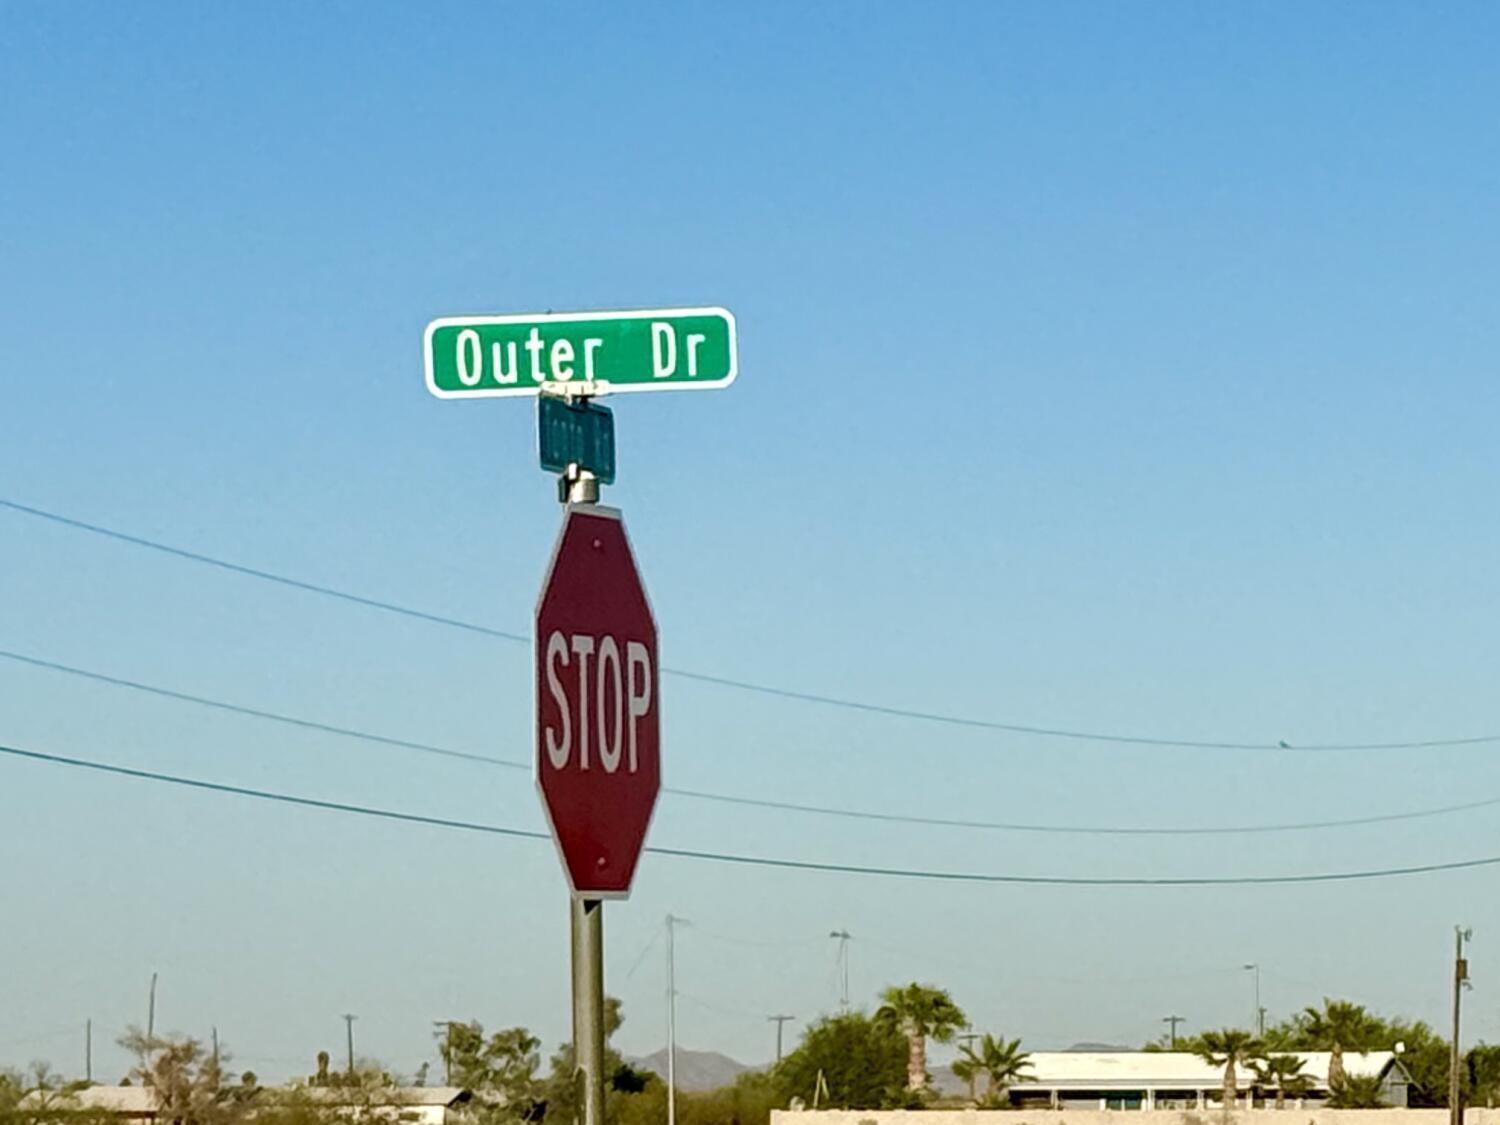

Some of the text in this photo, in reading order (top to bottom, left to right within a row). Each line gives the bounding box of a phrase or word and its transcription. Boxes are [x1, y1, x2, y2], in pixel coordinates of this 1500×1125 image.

[456, 322, 706, 386] Outer Dr
[546, 630, 653, 774] STOP
